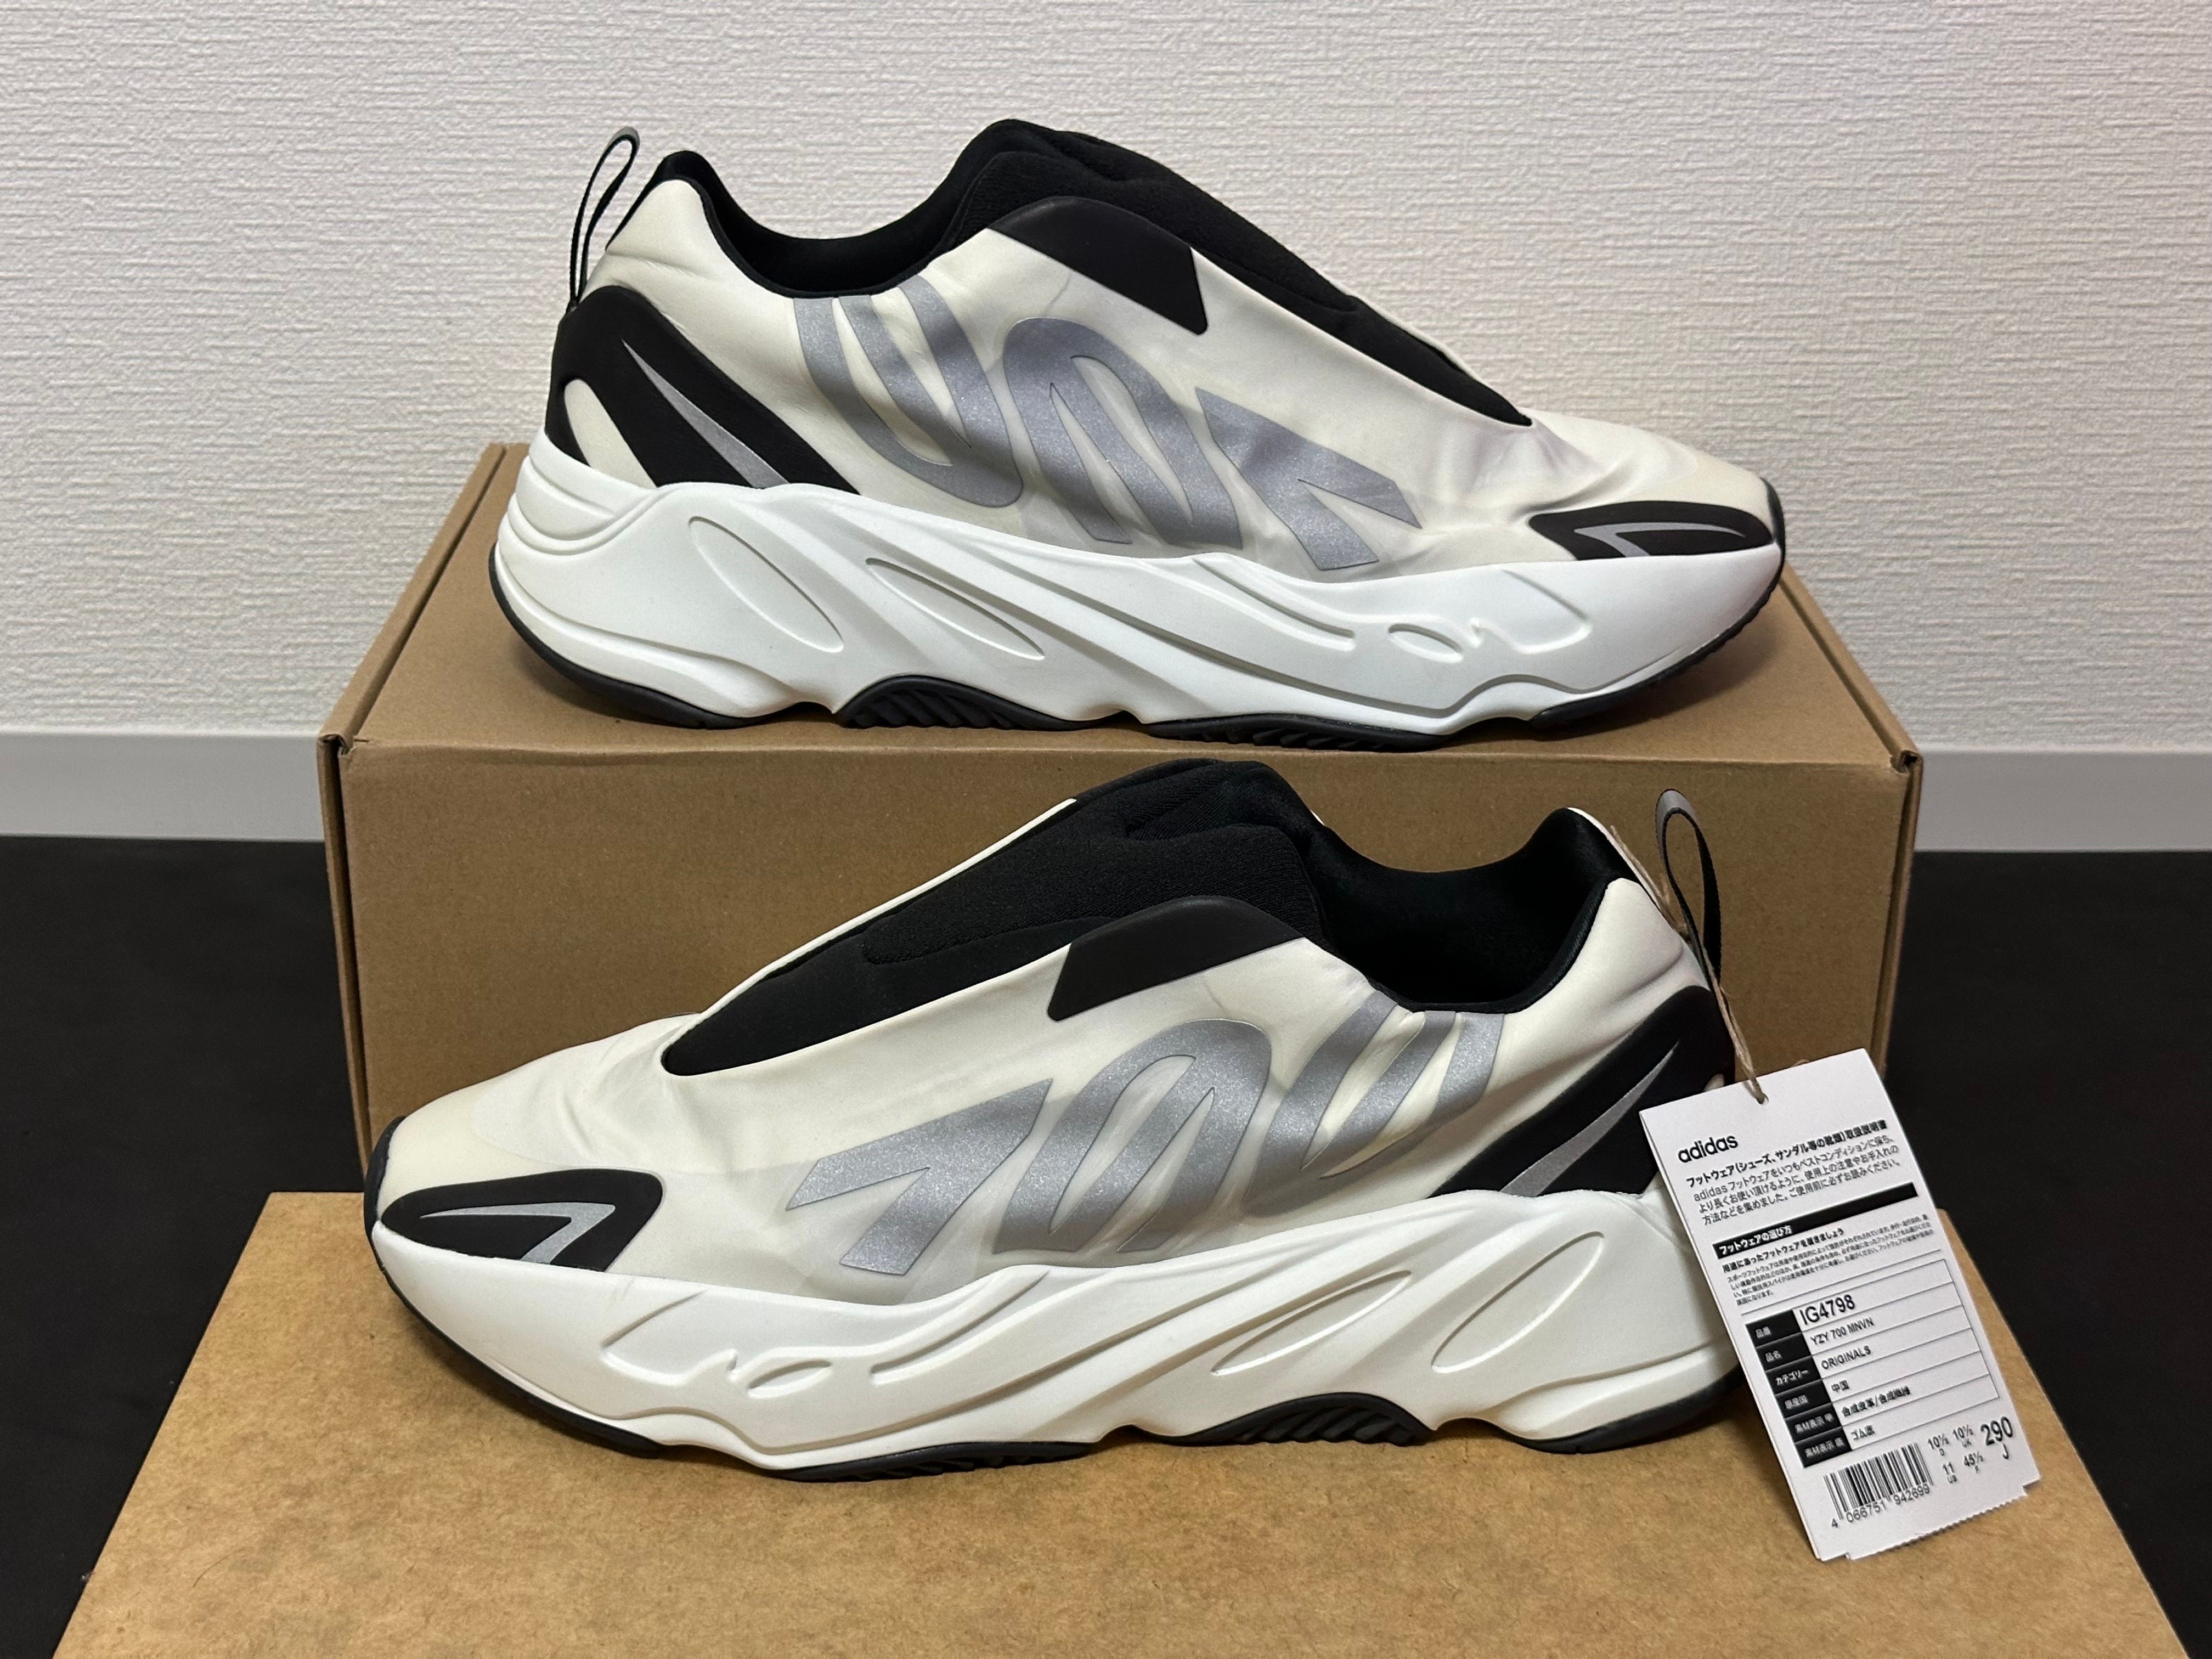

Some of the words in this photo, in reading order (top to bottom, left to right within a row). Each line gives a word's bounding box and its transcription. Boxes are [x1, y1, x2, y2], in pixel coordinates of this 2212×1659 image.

[1678, 1136, 1738, 1163] adidas
[1694, 1186, 1728, 1201] adidas
[1719, 1226, 1792, 1255] フットウェアの選び方
[1799, 1295, 1855, 1325] IG4798
[1810, 1332, 1829, 1345] YZY
[1830, 1327, 1847, 1339] 700
[1847, 1318, 1875, 1333] MNVN
[1776, 1370, 1808, 1385] カテゴリー
[1821, 1346, 1871, 1369] ORIGINALS
[1831, 1380, 1849, 1392] 中国
[1962, 1438, 1972, 1447] UK
[1980, 1417, 2013, 1446] 290
[2002, 1443, 2010, 1459] J
[1943, 1462, 1954, 1475] 11
[1832, 1519, 1839, 1528] 4
[1846, 1500, 1886, 1523] 066751
[1893, 1483, 1930, 1505] 942699
